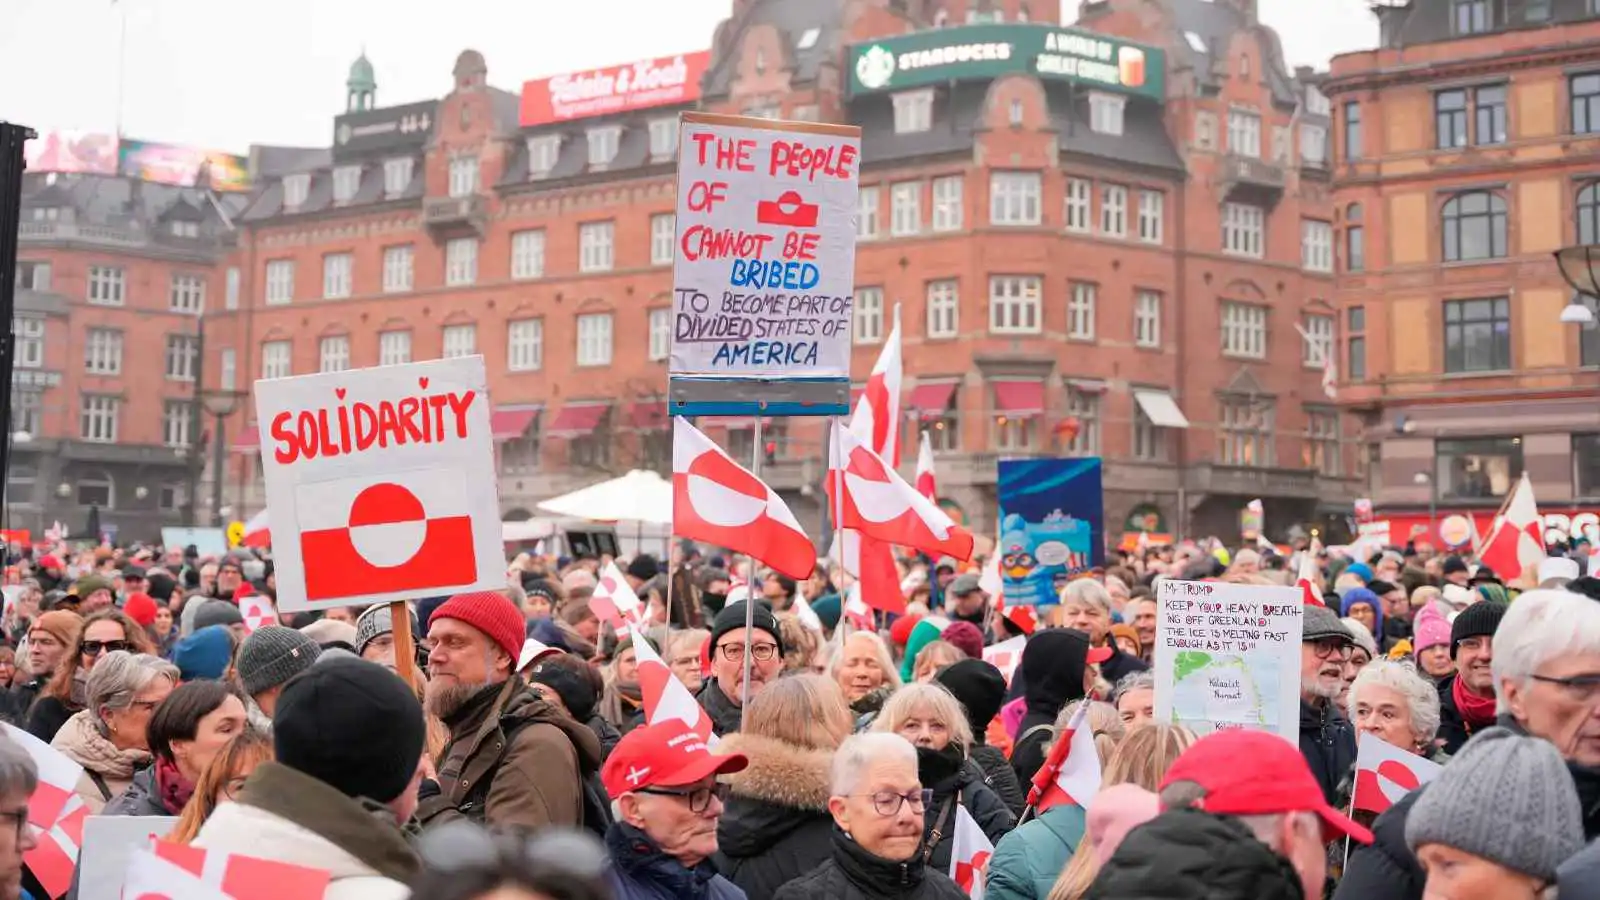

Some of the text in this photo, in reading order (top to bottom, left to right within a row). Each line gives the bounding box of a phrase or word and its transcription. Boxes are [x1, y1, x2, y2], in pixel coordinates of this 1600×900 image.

[899, 43, 1010, 70] STARBUCKS
[692, 133, 858, 183] THE PEOPLE
[687, 181, 728, 213] OF
[681, 225, 821, 261] CANNOT BE
[730, 259, 820, 289] BRIBED
[675, 288, 853, 316] TO BECOME PART OF
[676, 313, 848, 340] DIVIDED STATES OF
[712, 341, 818, 366] AMERICA
[270, 377, 476, 465] SOLIDARITY
[1180, 583, 1213, 596] TRUMP
[1165, 600, 1302, 617] KEEP YOUR HEAVY BREATH-
[1185, 616, 1204, 625] OFF
[1208, 616, 1271, 627] GREENLAND!
[1165, 627, 1289, 641] THE ICE IS MELTING FAST
[1166, 637, 1203, 648] ENOUGH
[1206, 641, 1220, 651] AS
[1222, 641, 1232, 650] IT
